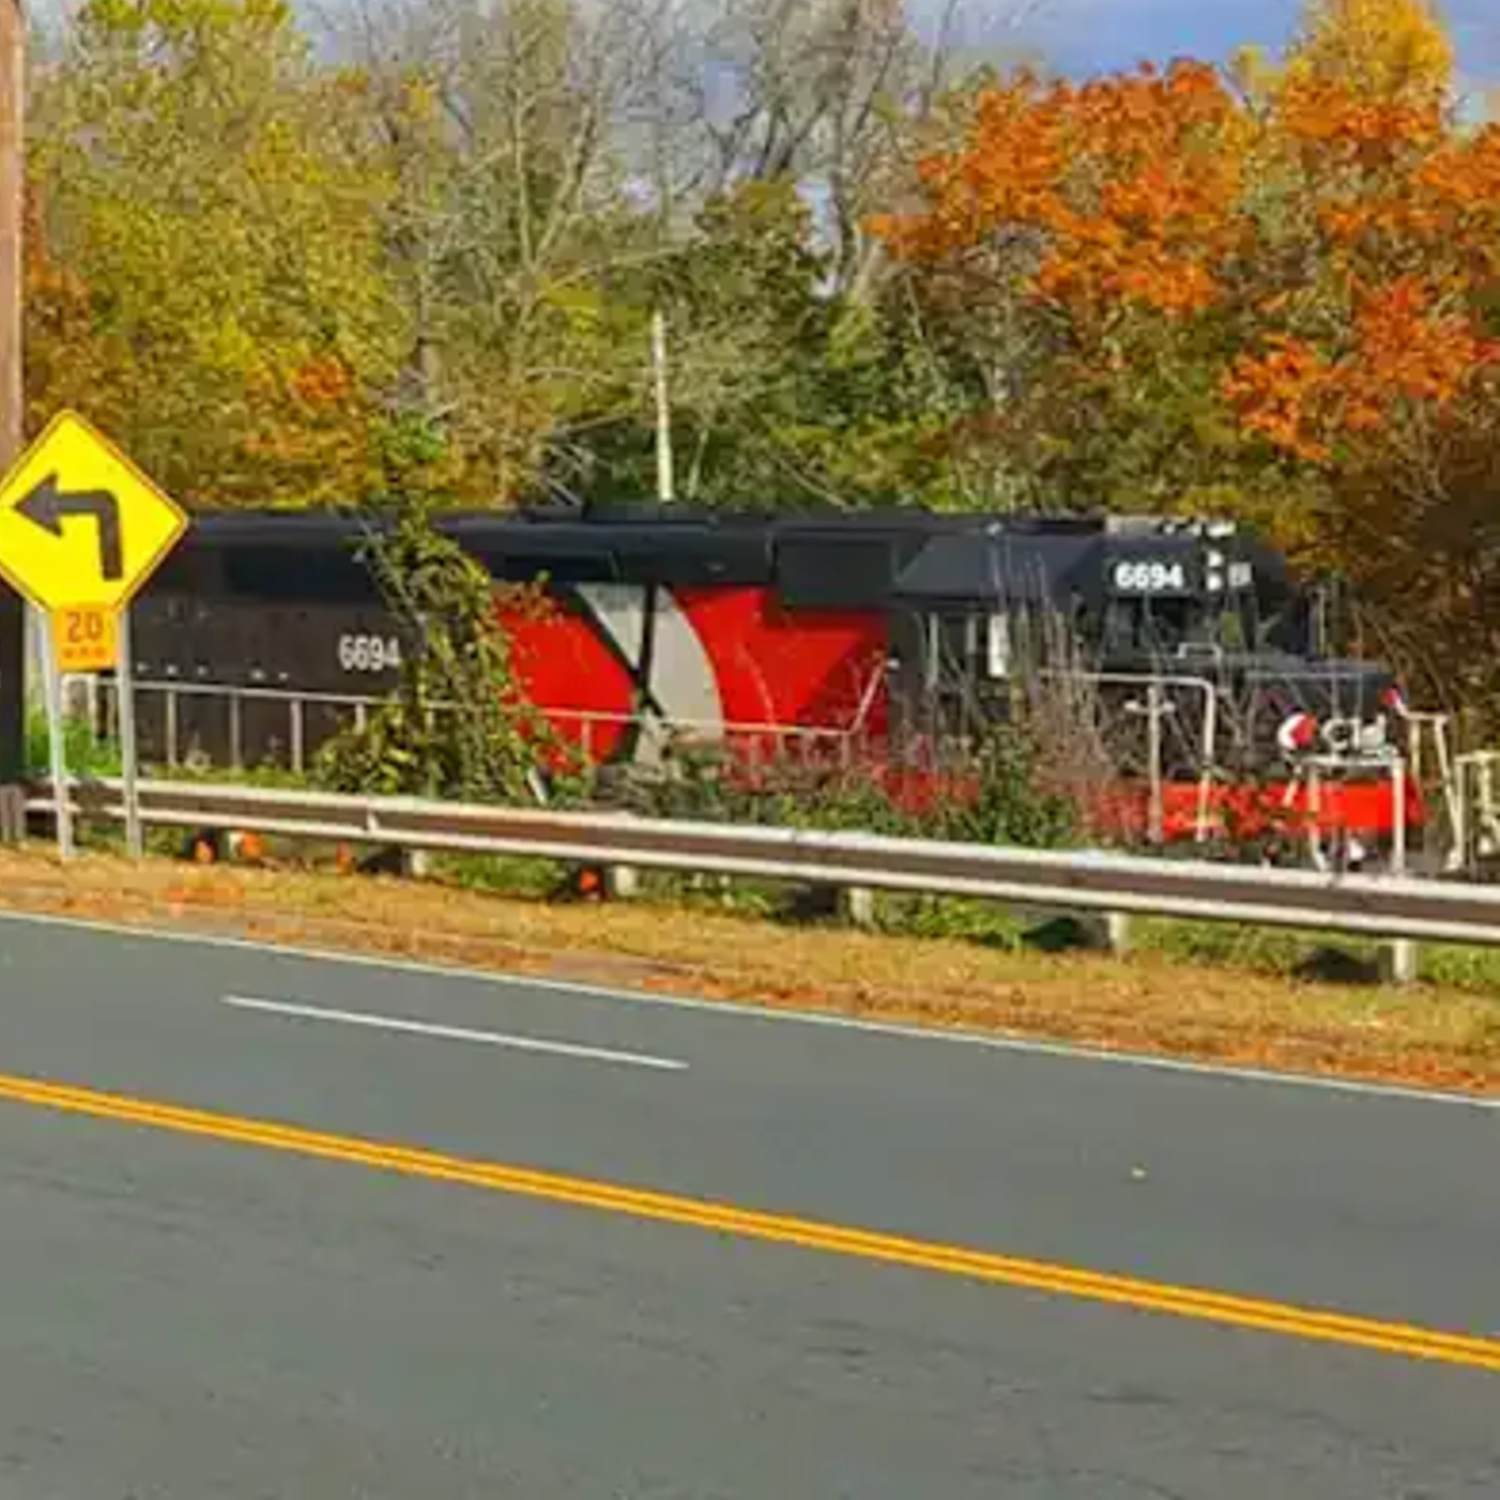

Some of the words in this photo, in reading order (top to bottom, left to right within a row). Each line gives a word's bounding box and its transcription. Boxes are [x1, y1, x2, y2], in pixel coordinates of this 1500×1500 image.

[1115, 562, 1184, 589] 6694
[65, 611, 103, 644] 20
[339, 634, 401, 671] 6694
